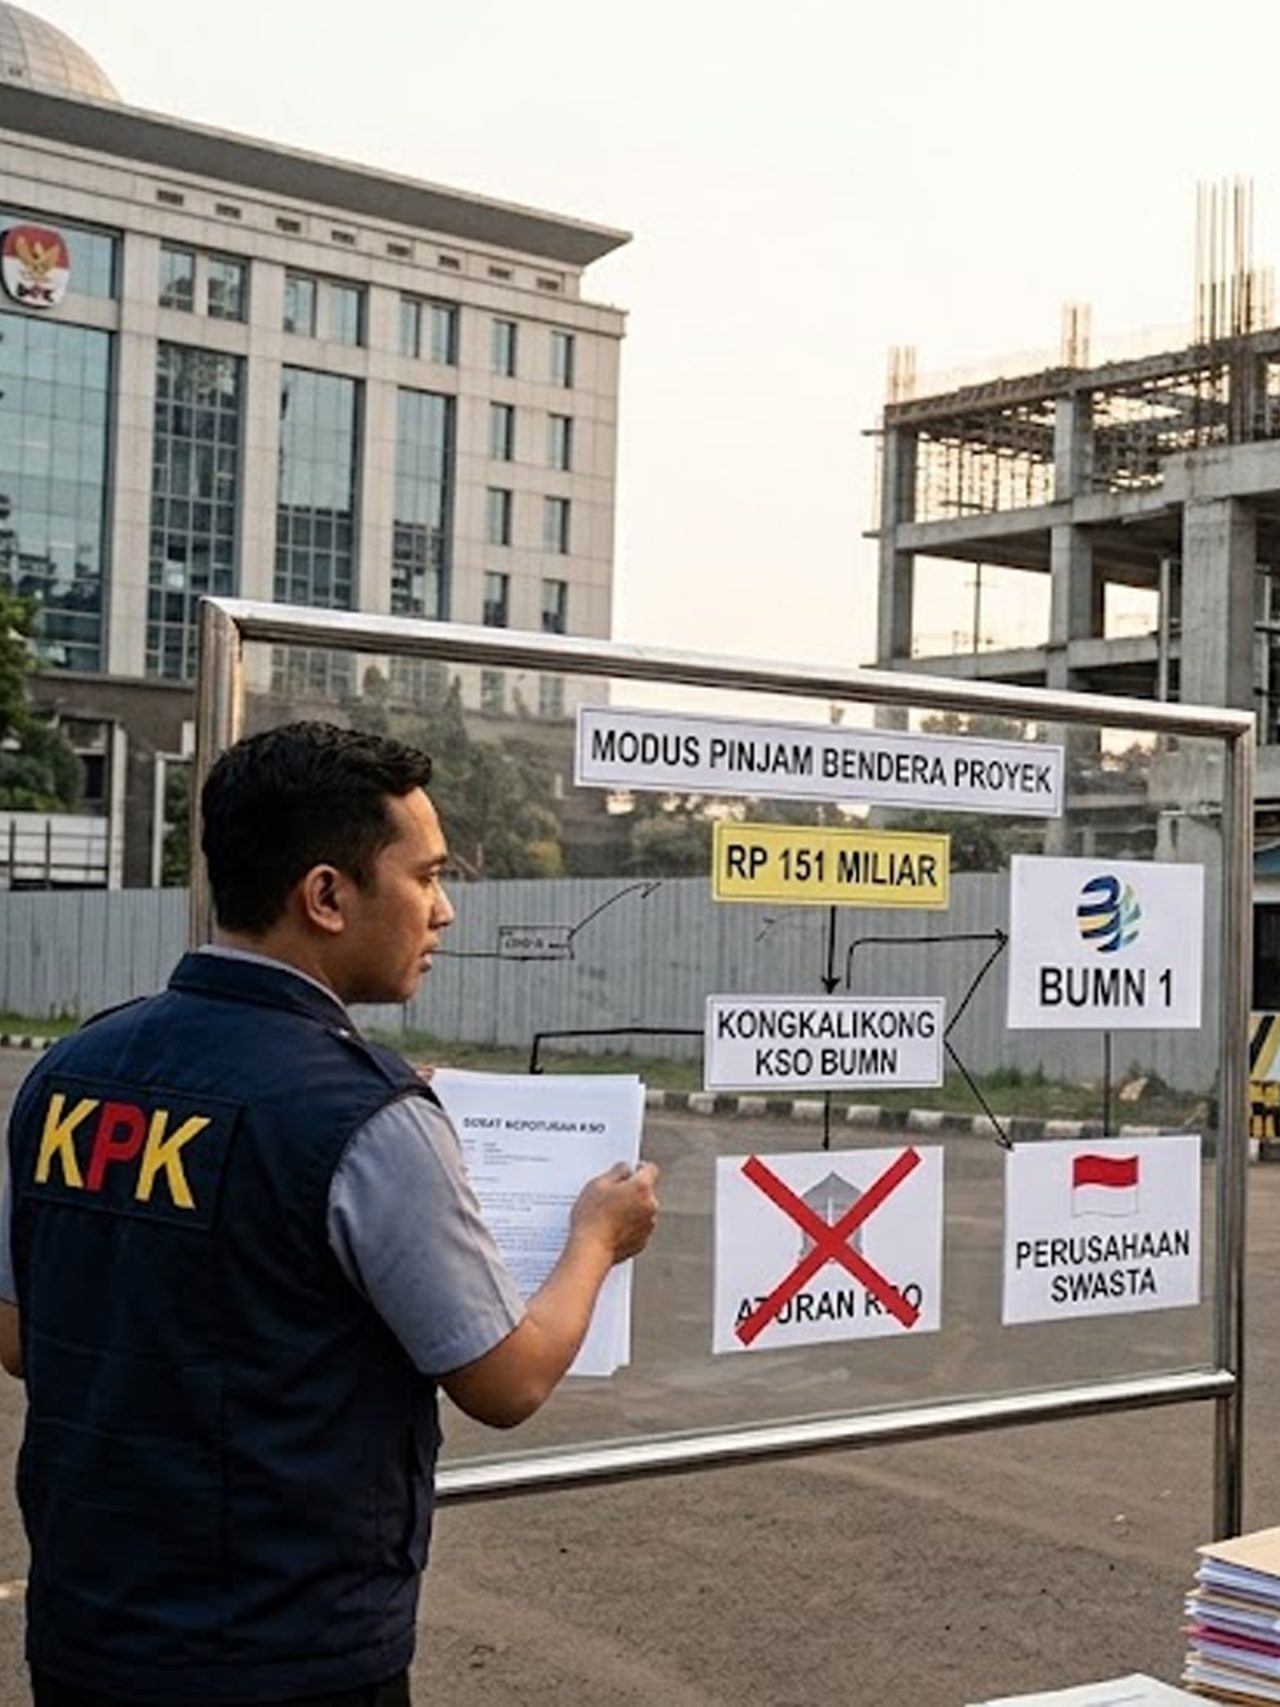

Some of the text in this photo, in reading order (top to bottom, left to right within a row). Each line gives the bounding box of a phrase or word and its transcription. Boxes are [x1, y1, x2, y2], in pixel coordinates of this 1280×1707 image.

[591, 729, 1053, 795] MODUS PINJAM BENDERA PROYEK
[726, 845, 938, 888] RP 151 MILIAR
[1039, 967, 1173, 1007] BUMN 1
[717, 1010, 936, 1041] KONGKALIKONG
[755, 1047, 898, 1076] KSO BUMN
[34, 1093, 212, 1210] KPK
[1016, 1230, 1190, 1269] PERUSAHAAN
[864, 1282, 923, 1317] KO
[1050, 1268, 1156, 1303] SWASTA
